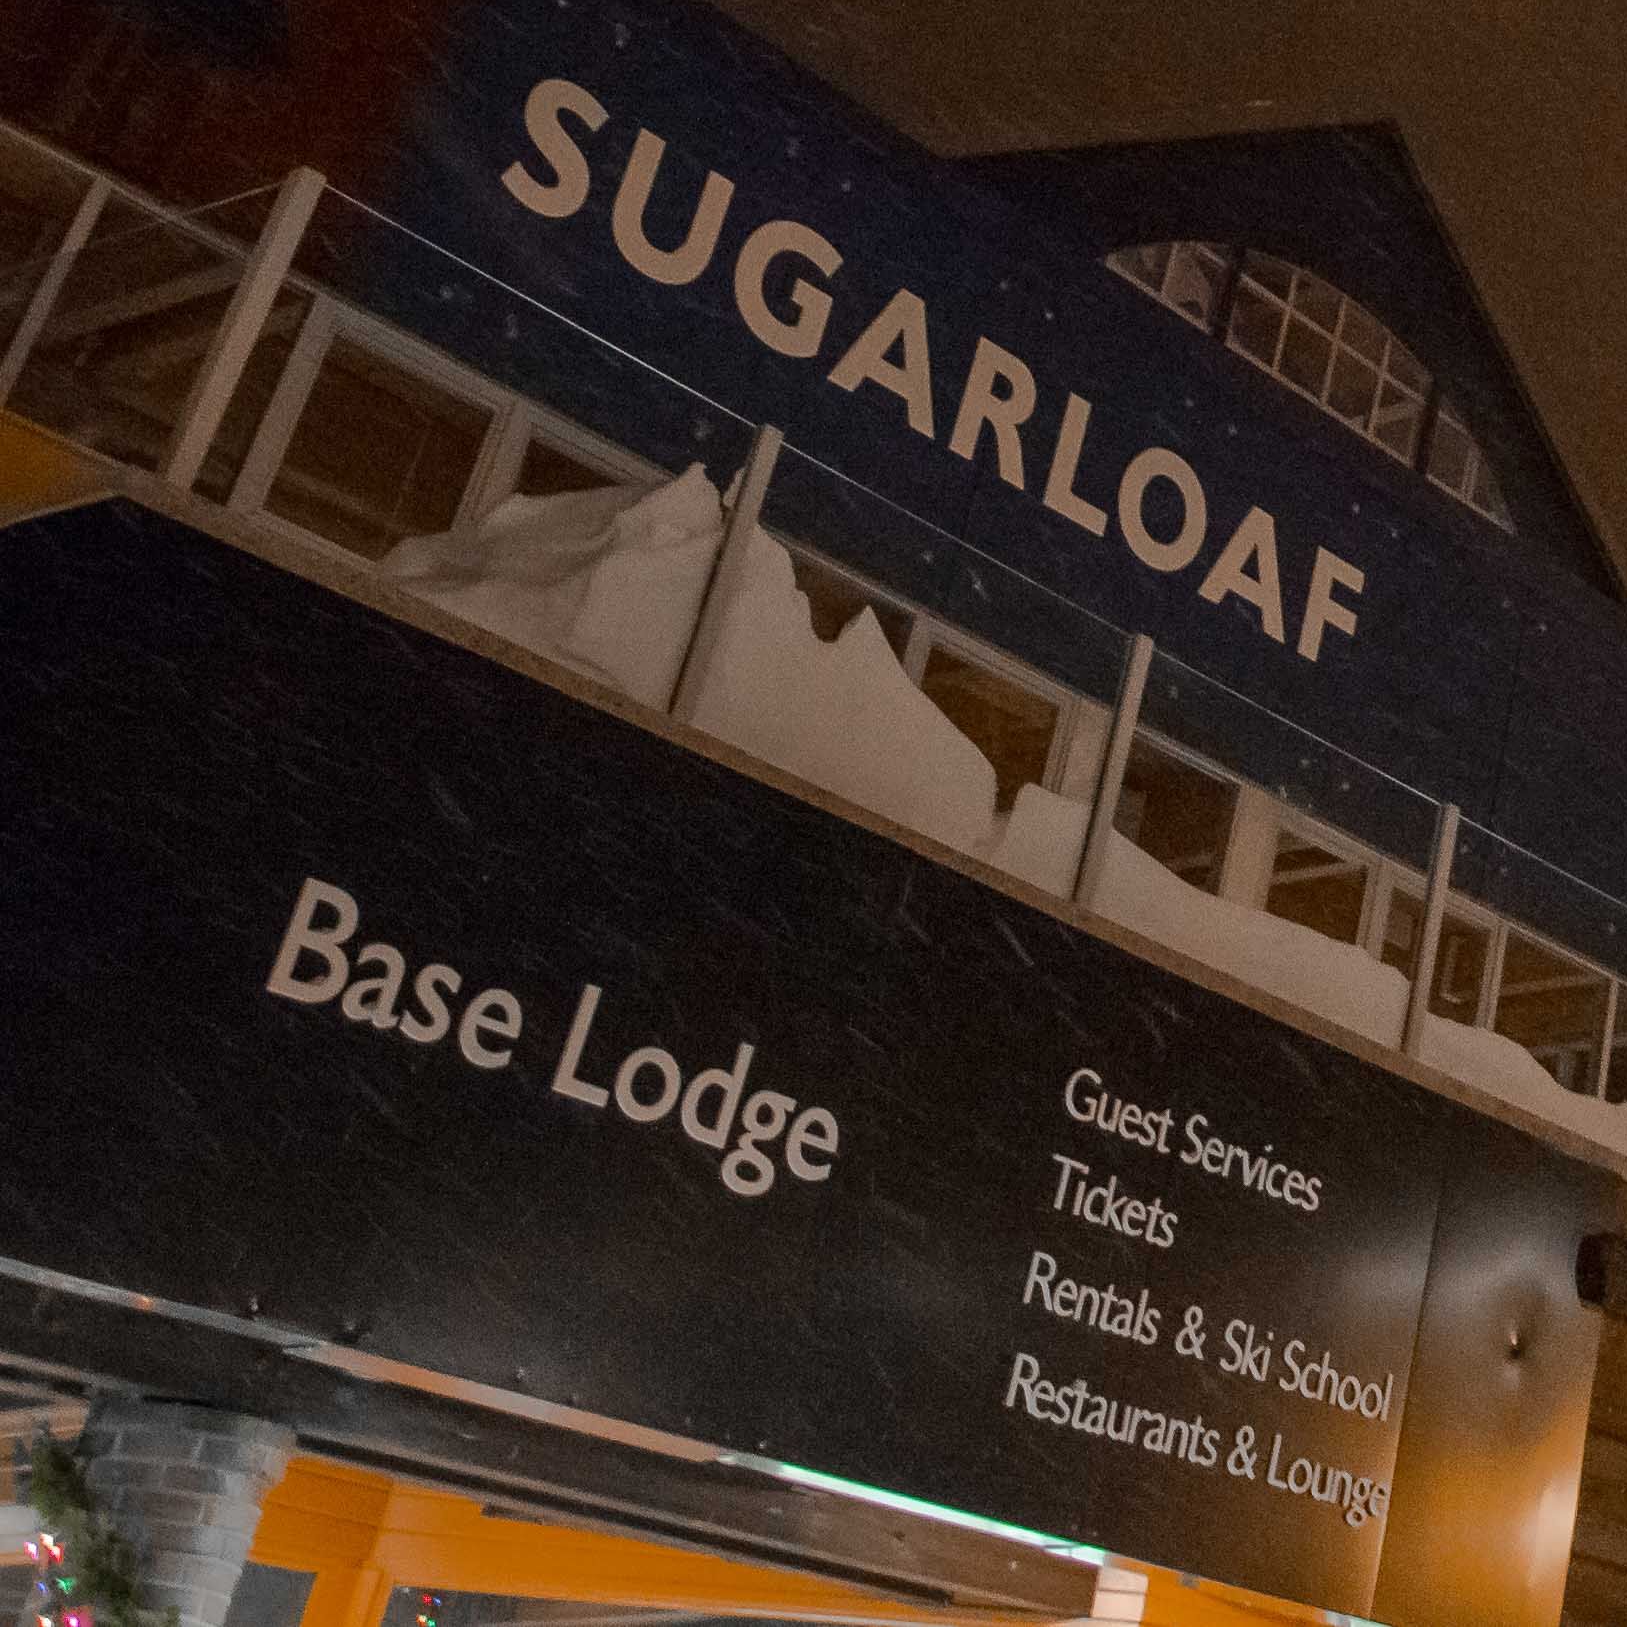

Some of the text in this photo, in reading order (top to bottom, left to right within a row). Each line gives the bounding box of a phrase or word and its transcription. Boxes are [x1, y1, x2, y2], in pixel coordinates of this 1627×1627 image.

[500, 78, 1366, 663] SUGARLOAF
[266, 877, 840, 1197] Base Lodge
[1052, 1153, 1178, 1249] Tickets
[1064, 1068, 1323, 1212] Guest Services
[1023, 1251, 1394, 1422] Rentals & Ski School
[1004, 1352, 1220, 1468] Restaurants
[1227, 1425, 1257, 1481] &
